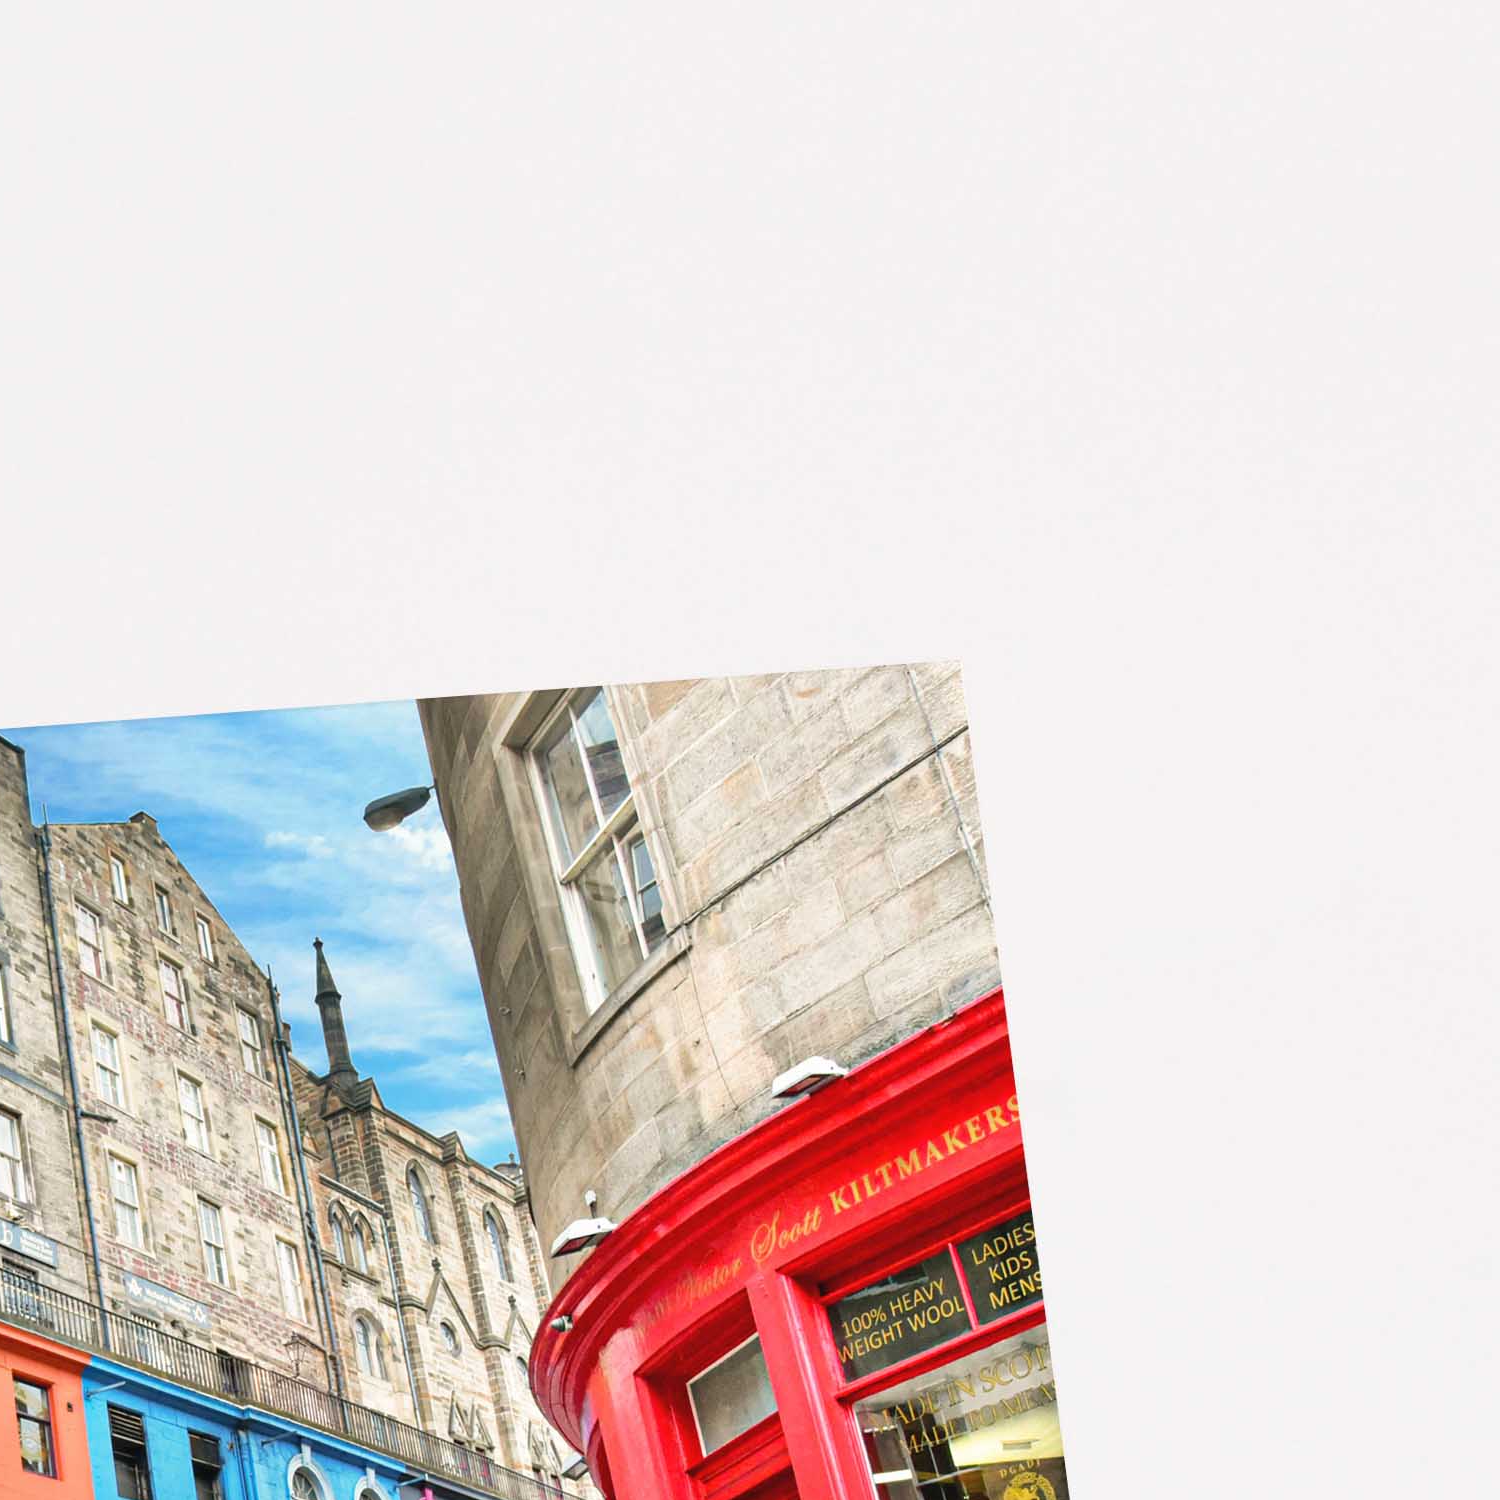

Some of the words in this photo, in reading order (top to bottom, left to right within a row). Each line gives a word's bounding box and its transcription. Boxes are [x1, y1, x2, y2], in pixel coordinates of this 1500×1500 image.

[751, 1206, 821, 1264] Scott
[828, 1094, 1019, 1215] KILTMAKERS
[971, 1221, 1034, 1266] LADIES
[988, 1250, 1032, 1283] KIDS
[838, 1320, 903, 1363] WEIGHT
[906, 1295, 965, 1333] WOOL
[841, 1305, 887, 1339] 100%
[889, 1277, 945, 1317] HEAVY
